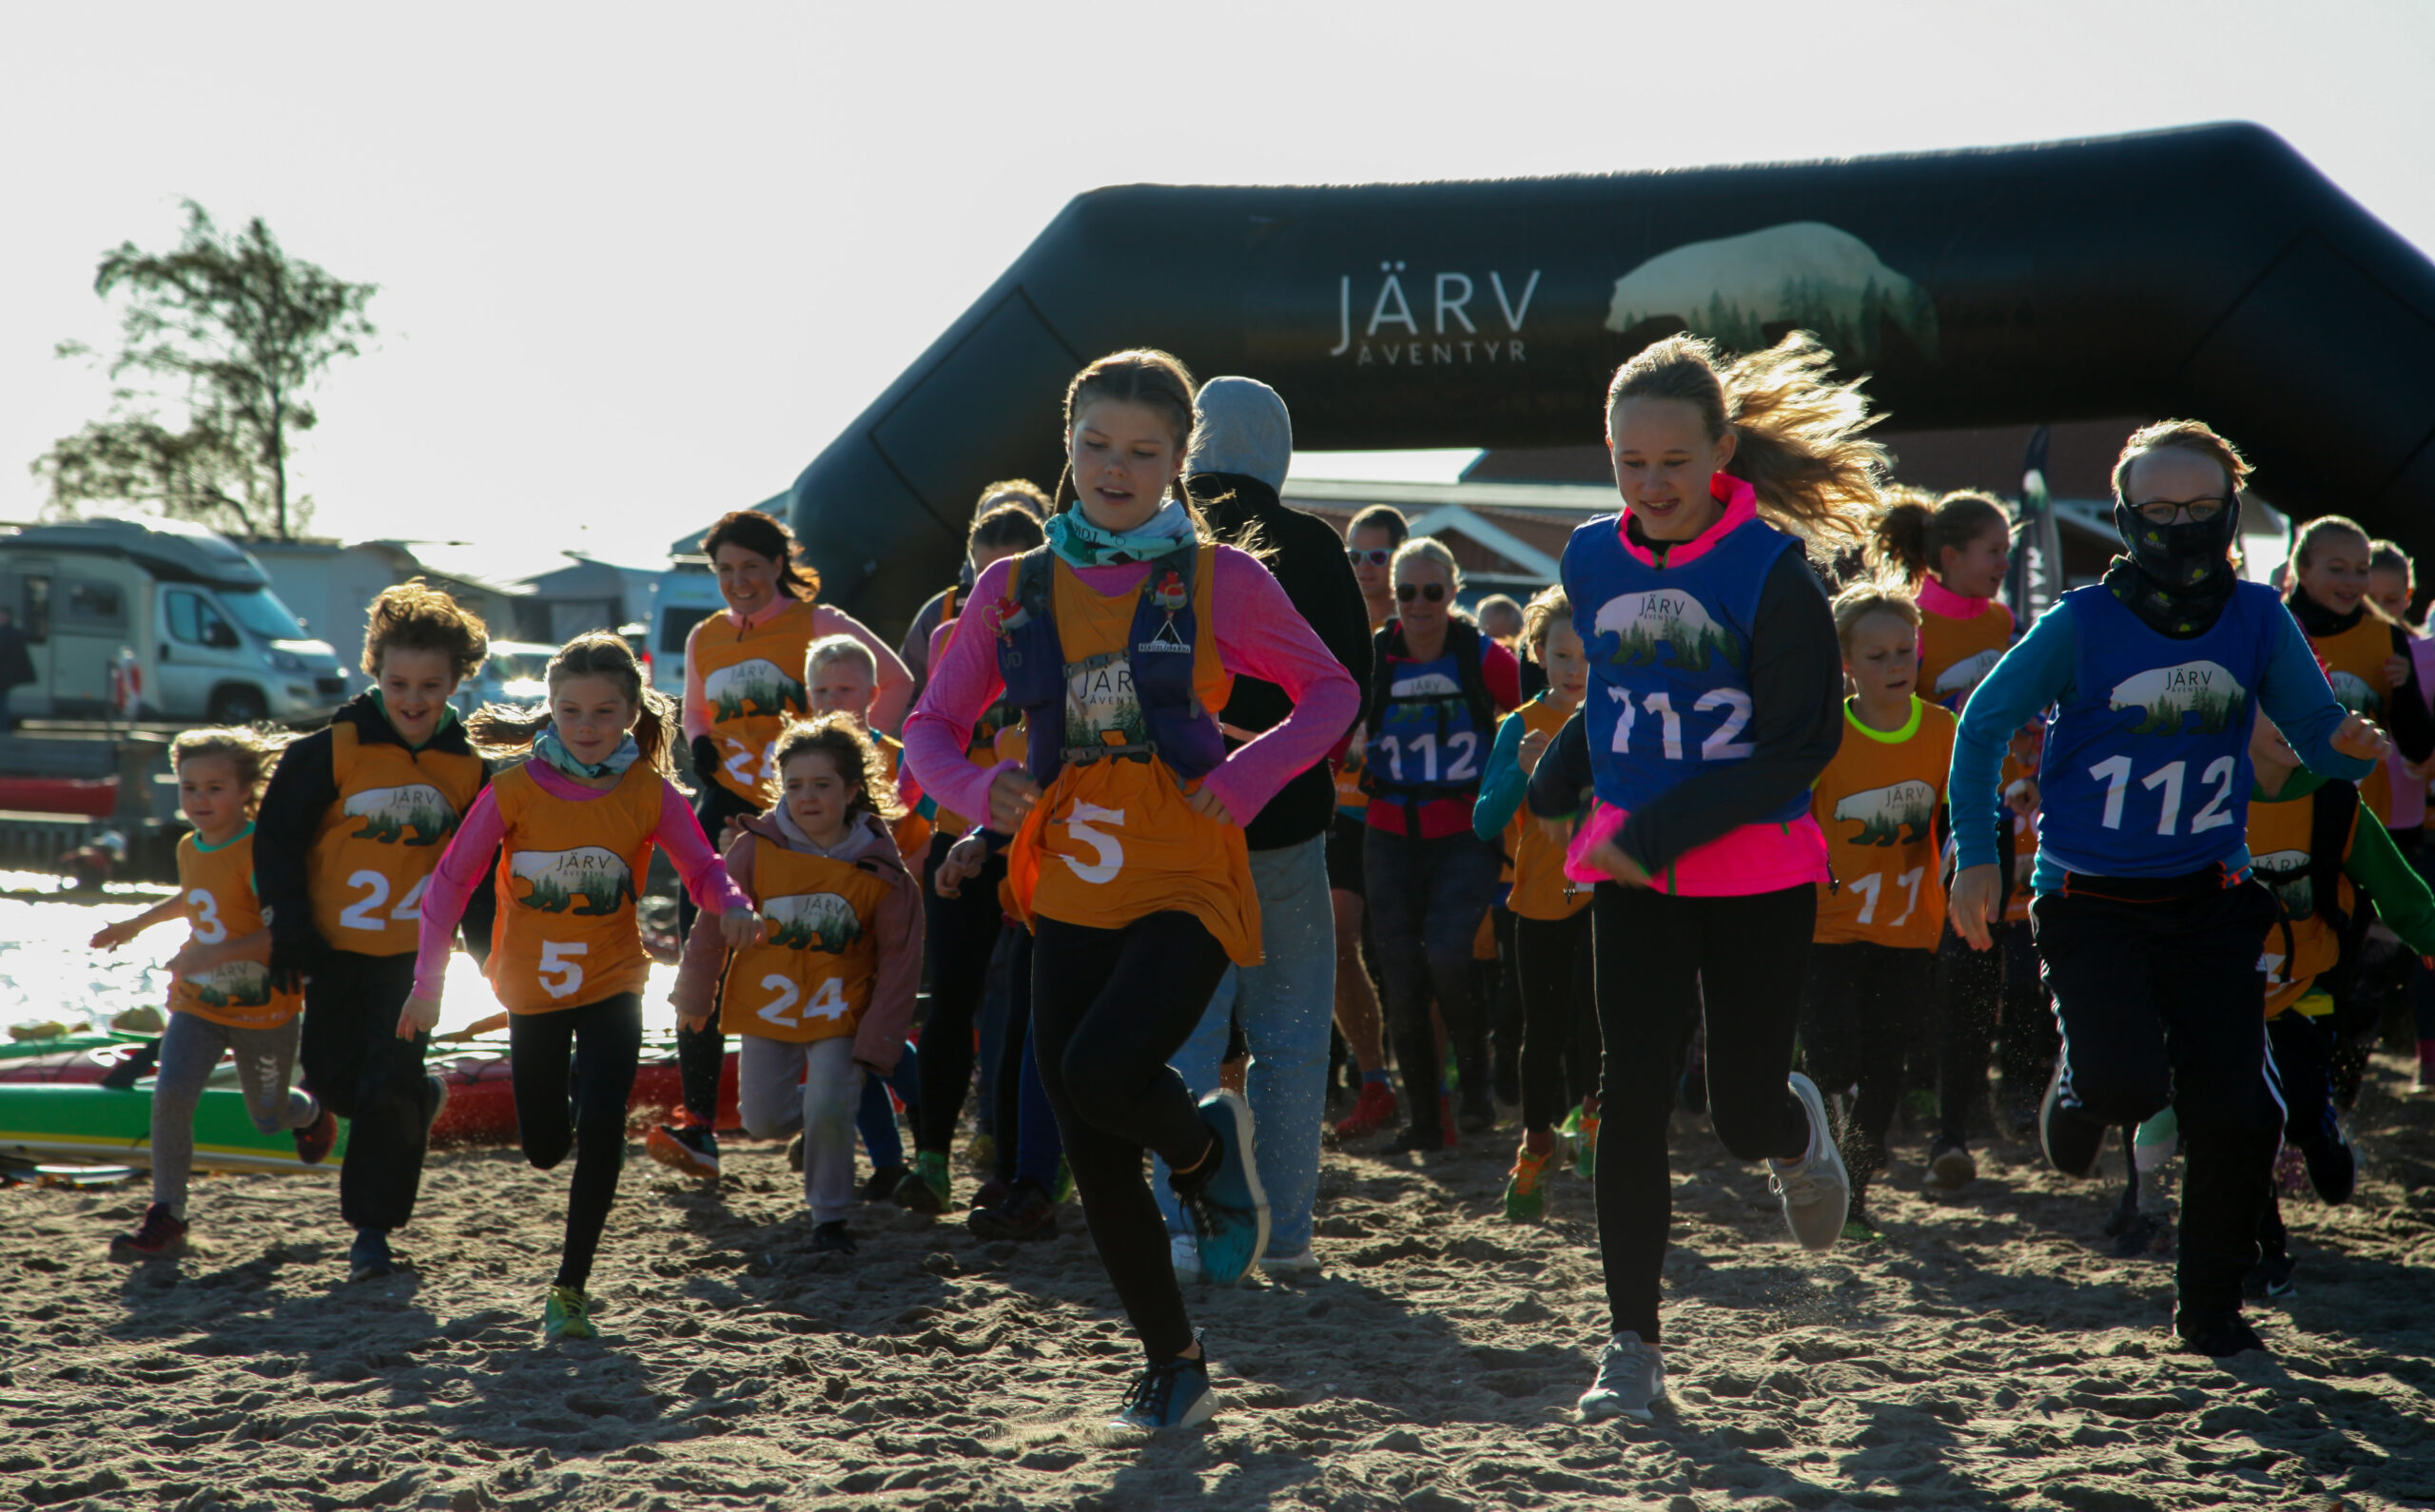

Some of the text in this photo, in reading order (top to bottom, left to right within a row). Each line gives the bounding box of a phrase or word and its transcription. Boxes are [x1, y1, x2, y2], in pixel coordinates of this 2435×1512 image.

[1330, 261, 1540, 356] JÄRV
[1357, 339, 1526, 366] ÄVENTYR
[1639, 593, 1685, 617] JÄRV
[1080, 665, 1133, 700] JÄR
[1089, 694, 1133, 705] ÄVENT
[2165, 668, 2213, 690] JÄRV
[1607, 686, 1759, 761] 112
[1381, 731, 1478, 782] 112
[390, 788, 438, 807] JÄRV
[1885, 785, 1926, 807] JÄRV
[2088, 754, 2236, 836] 112
[555, 851, 611, 872] JÄRV
[1058, 797, 1125, 884] 5
[187, 888, 227, 944] 3
[537, 940, 588, 999] 5
[756, 974, 849, 1028] 24
